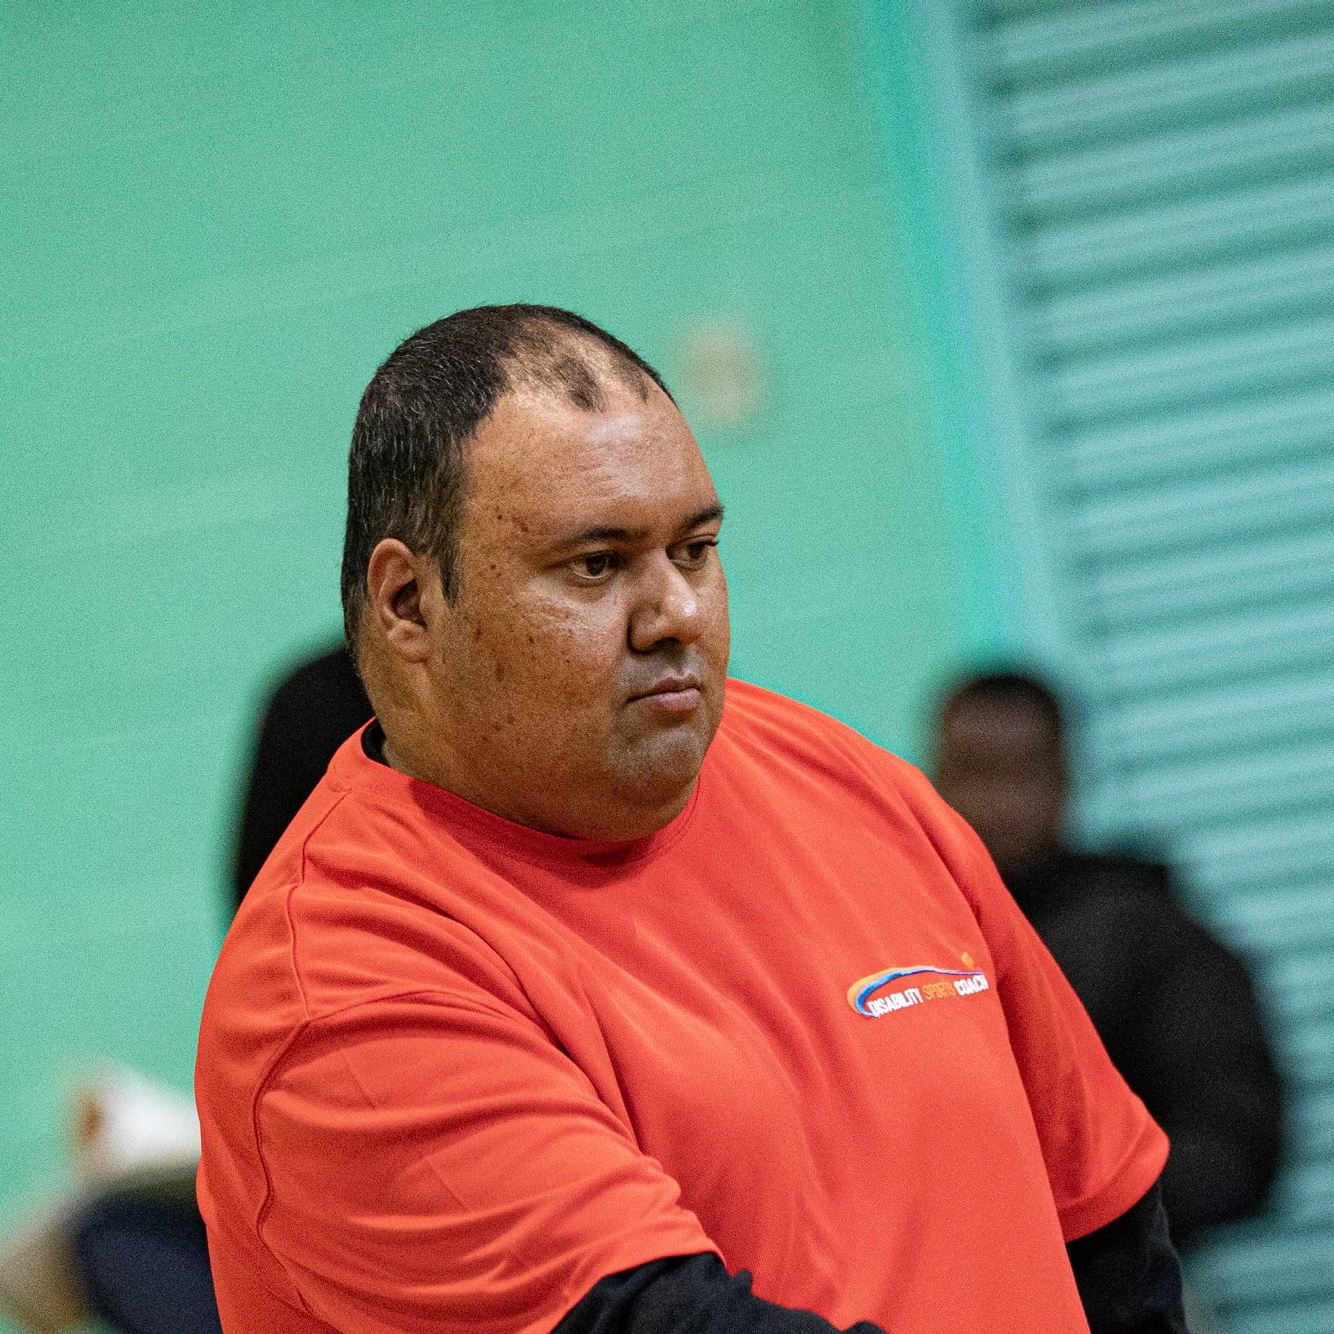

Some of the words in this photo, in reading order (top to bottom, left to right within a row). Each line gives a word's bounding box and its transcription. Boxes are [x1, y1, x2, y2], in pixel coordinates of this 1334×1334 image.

[868, 988, 923, 1017] DISABILITY
[923, 982, 955, 1000] SPORTS
[955, 974, 989, 995] COACH
